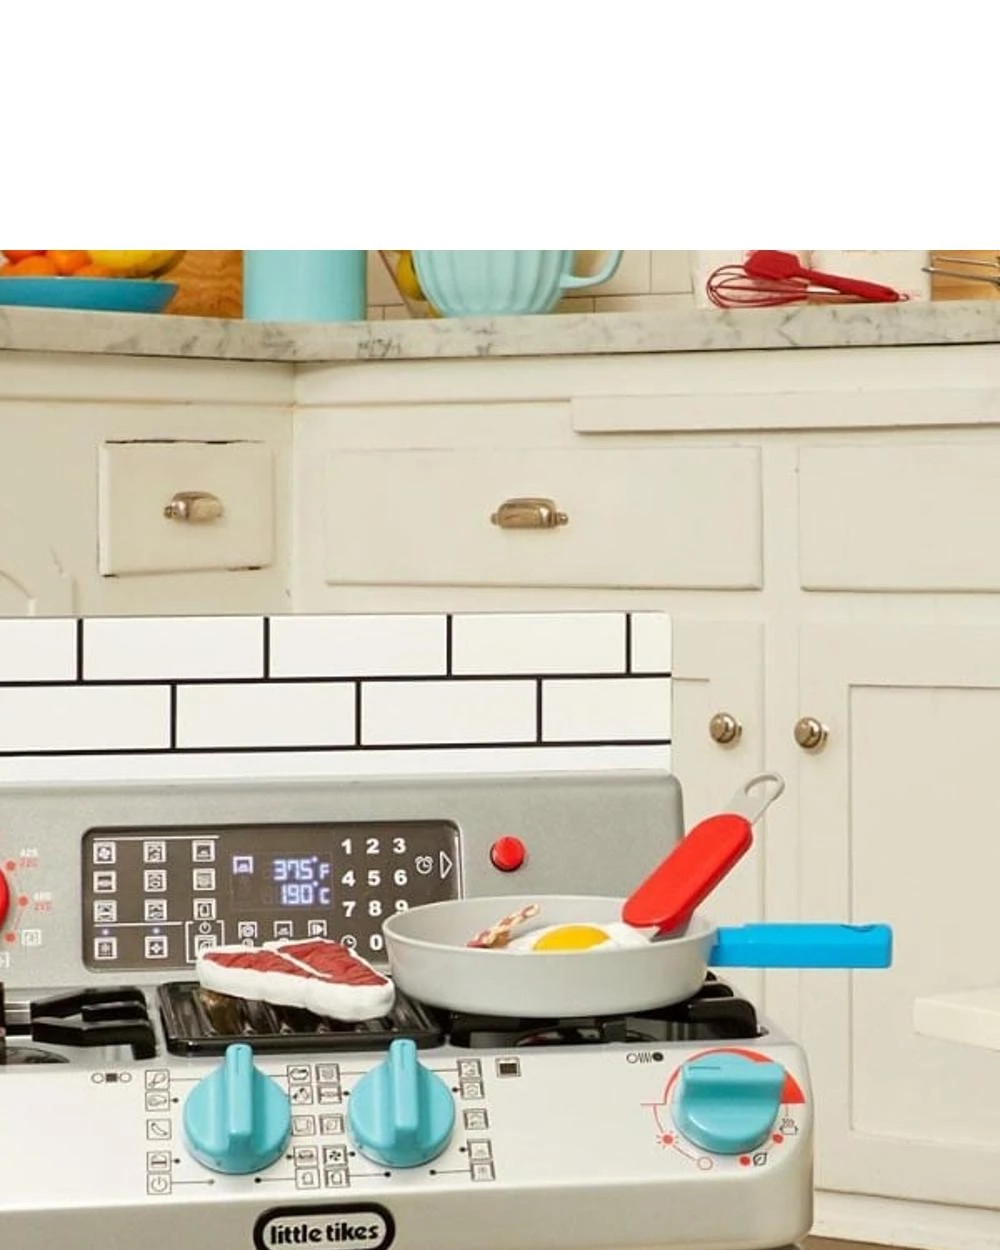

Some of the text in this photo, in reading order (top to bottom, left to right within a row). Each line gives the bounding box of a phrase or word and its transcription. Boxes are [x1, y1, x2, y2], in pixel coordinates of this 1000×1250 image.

[341, 838, 406, 854] 1 2 3
[341, 870, 407, 886] 4 5 6
[342, 900, 408, 917] 7 8 9
[370, 934, 383, 950] 0
[270, 1222, 379, 1244] little tikes
